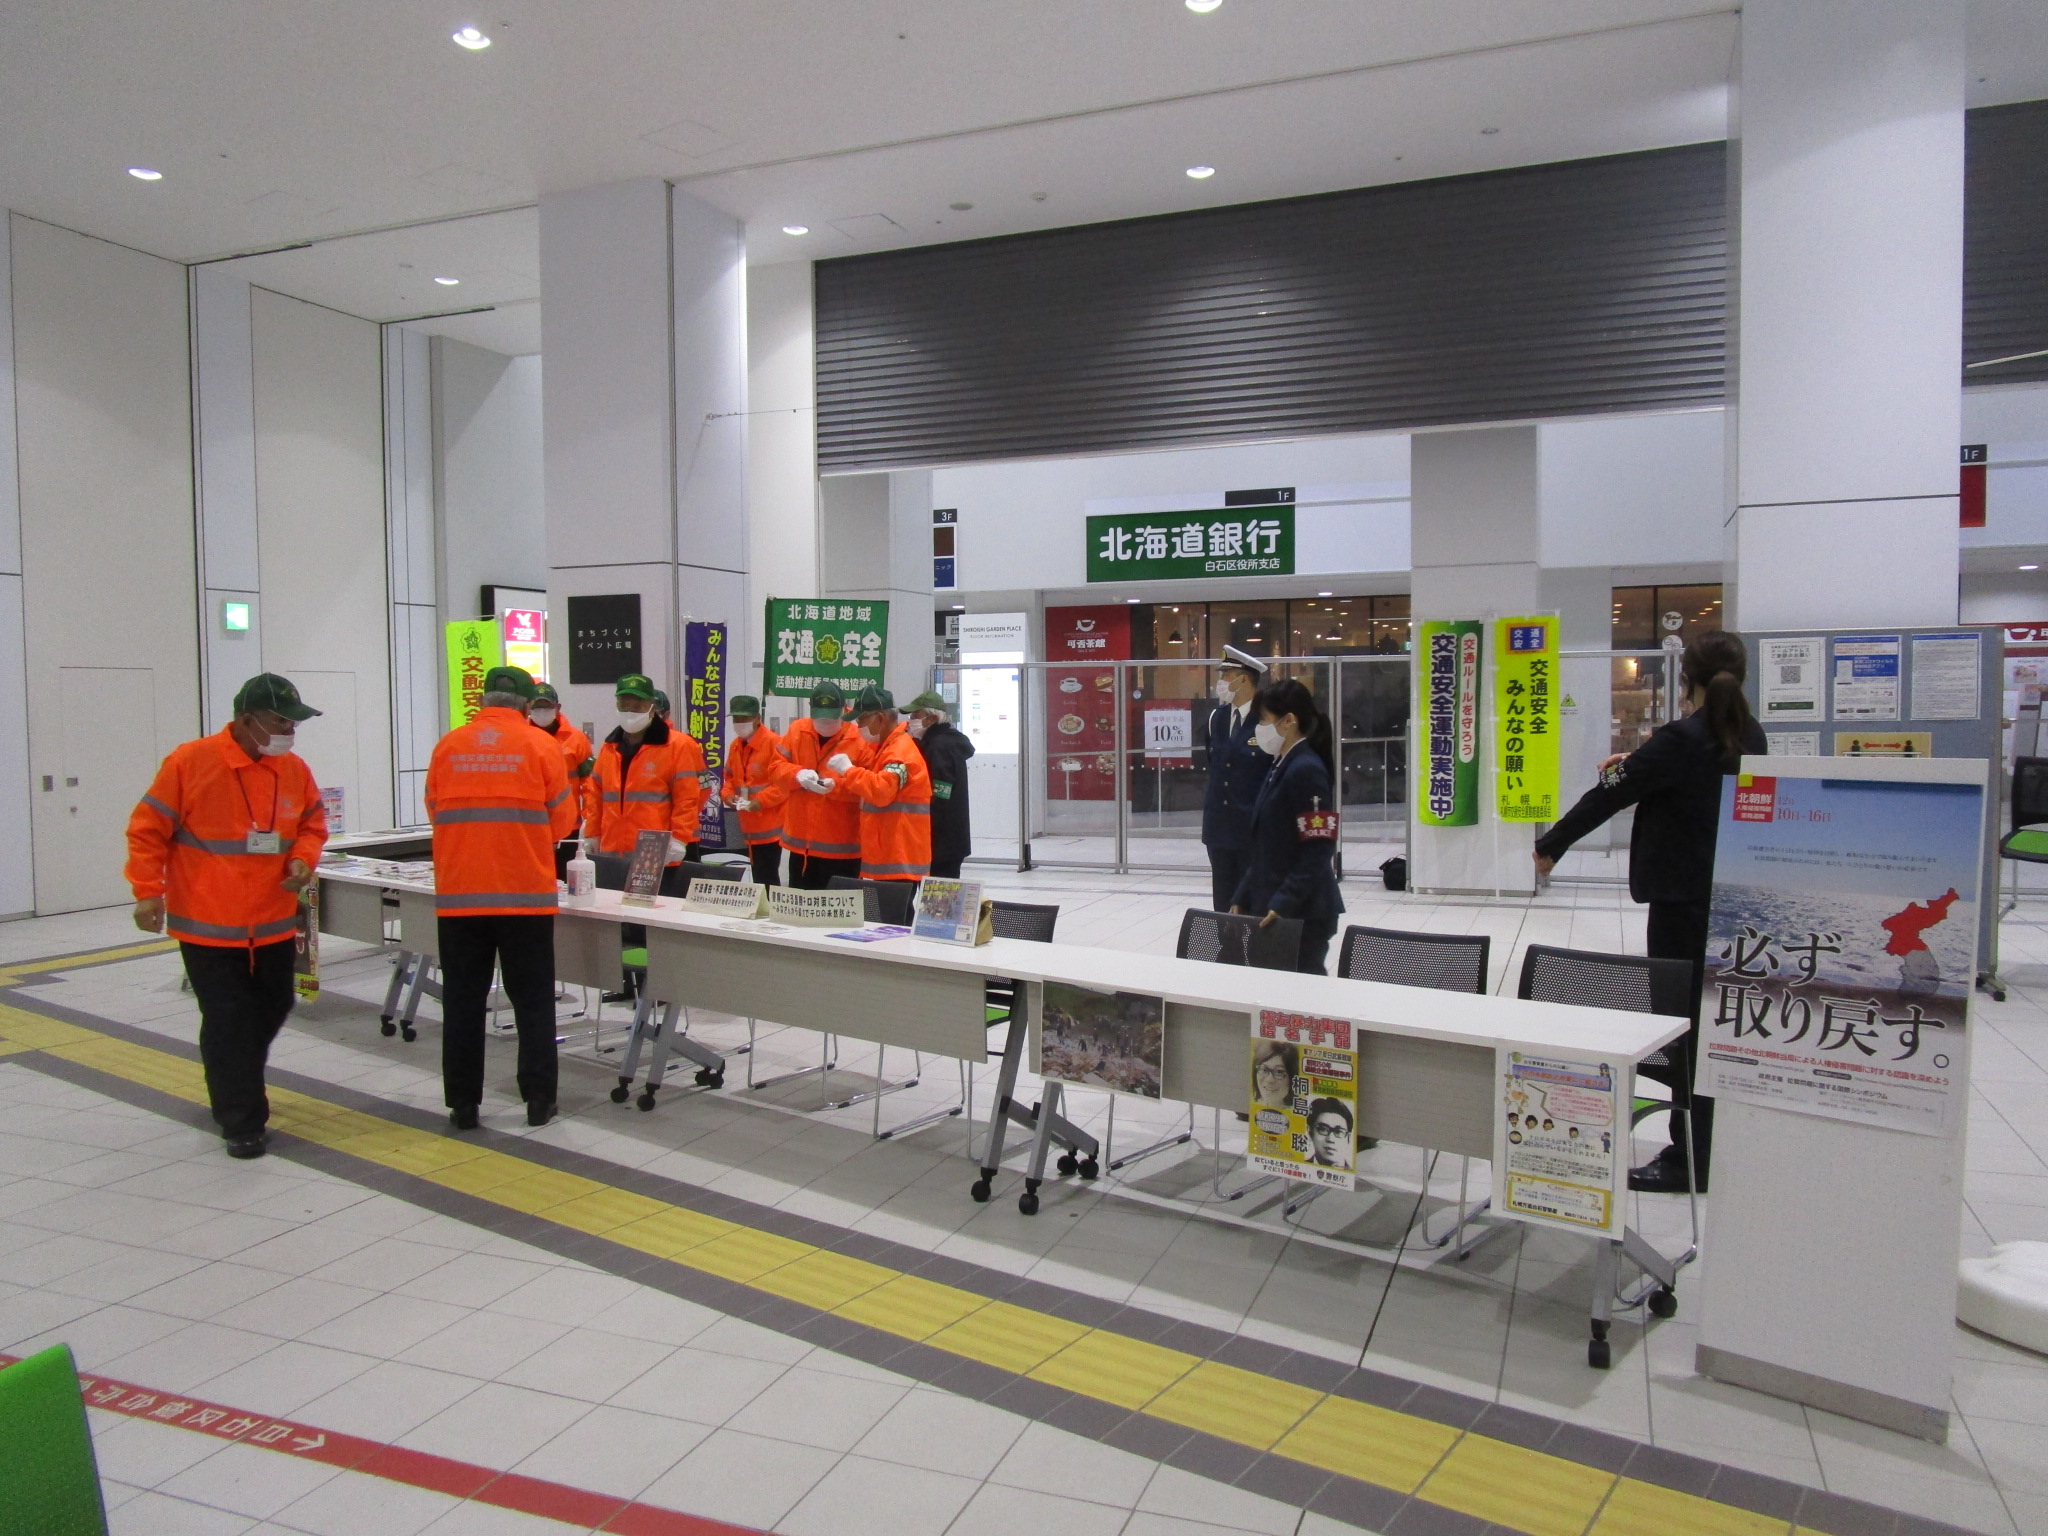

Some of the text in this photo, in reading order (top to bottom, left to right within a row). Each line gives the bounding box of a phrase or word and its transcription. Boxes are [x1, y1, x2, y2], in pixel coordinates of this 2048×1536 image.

[1963, 448, 1979, 460] 1F
[1277, 490, 1290, 502] 1F
[941, 512, 952, 522] 3F
[1099, 518, 1281, 562] 北海道銀行
[1205, 557, 1281, 572] 白石区役所支店
[787, 604, 872, 621] 北海道地域
[577, 628, 632, 637] まちづくり
[577, 641, 633, 650] イベント広場
[777, 628, 882, 667] 交通 安全
[705, 629, 723, 769] みんなでつけよう
[1461, 639, 1476, 756] 交通ルールを守ろう
[1529, 658, 1549, 735] 交通安全
[1429, 632, 1456, 819] 交通安全運動実施中
[1505, 679, 1525, 791] みんなの願い
[1737, 792, 1773, 805] 北朝鮮
[1716, 925, 1842, 987] 必ず
[1714, 982, 1950, 1069] 取り戻す。
[1254, 1156, 1300, 1170] 似ていると思ったら
